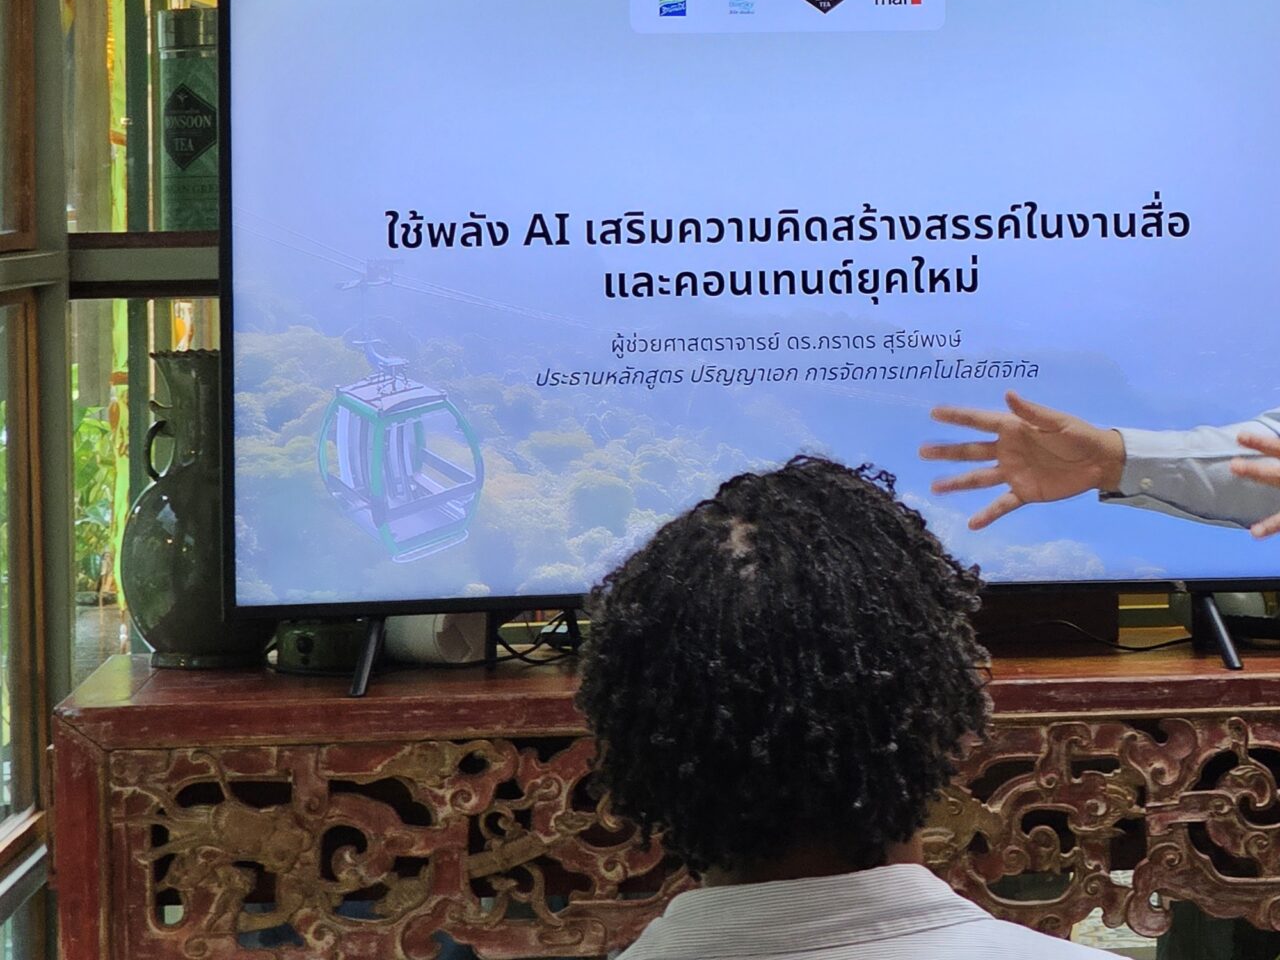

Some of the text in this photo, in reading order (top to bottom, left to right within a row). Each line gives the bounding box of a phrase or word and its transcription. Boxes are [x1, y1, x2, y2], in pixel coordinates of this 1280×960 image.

[174, 138, 194, 151] TEA
[384, 191, 1190, 249] ใช้พลัง AI เสริมความคิดสร้างสรรค์ในงานสื่อ
[604, 254, 979, 305] และคอนเทนต์ยุคใหม่
[611, 332, 781, 359] ผู้ช่วยศาสตราจารย์
[787, 335, 876, 350] ดร.ภราดร
[536, 359, 1040, 390] ประธานหลักสูตร ปริญญาเอก การจัดการเทคโนโลยีดิจิทัล
